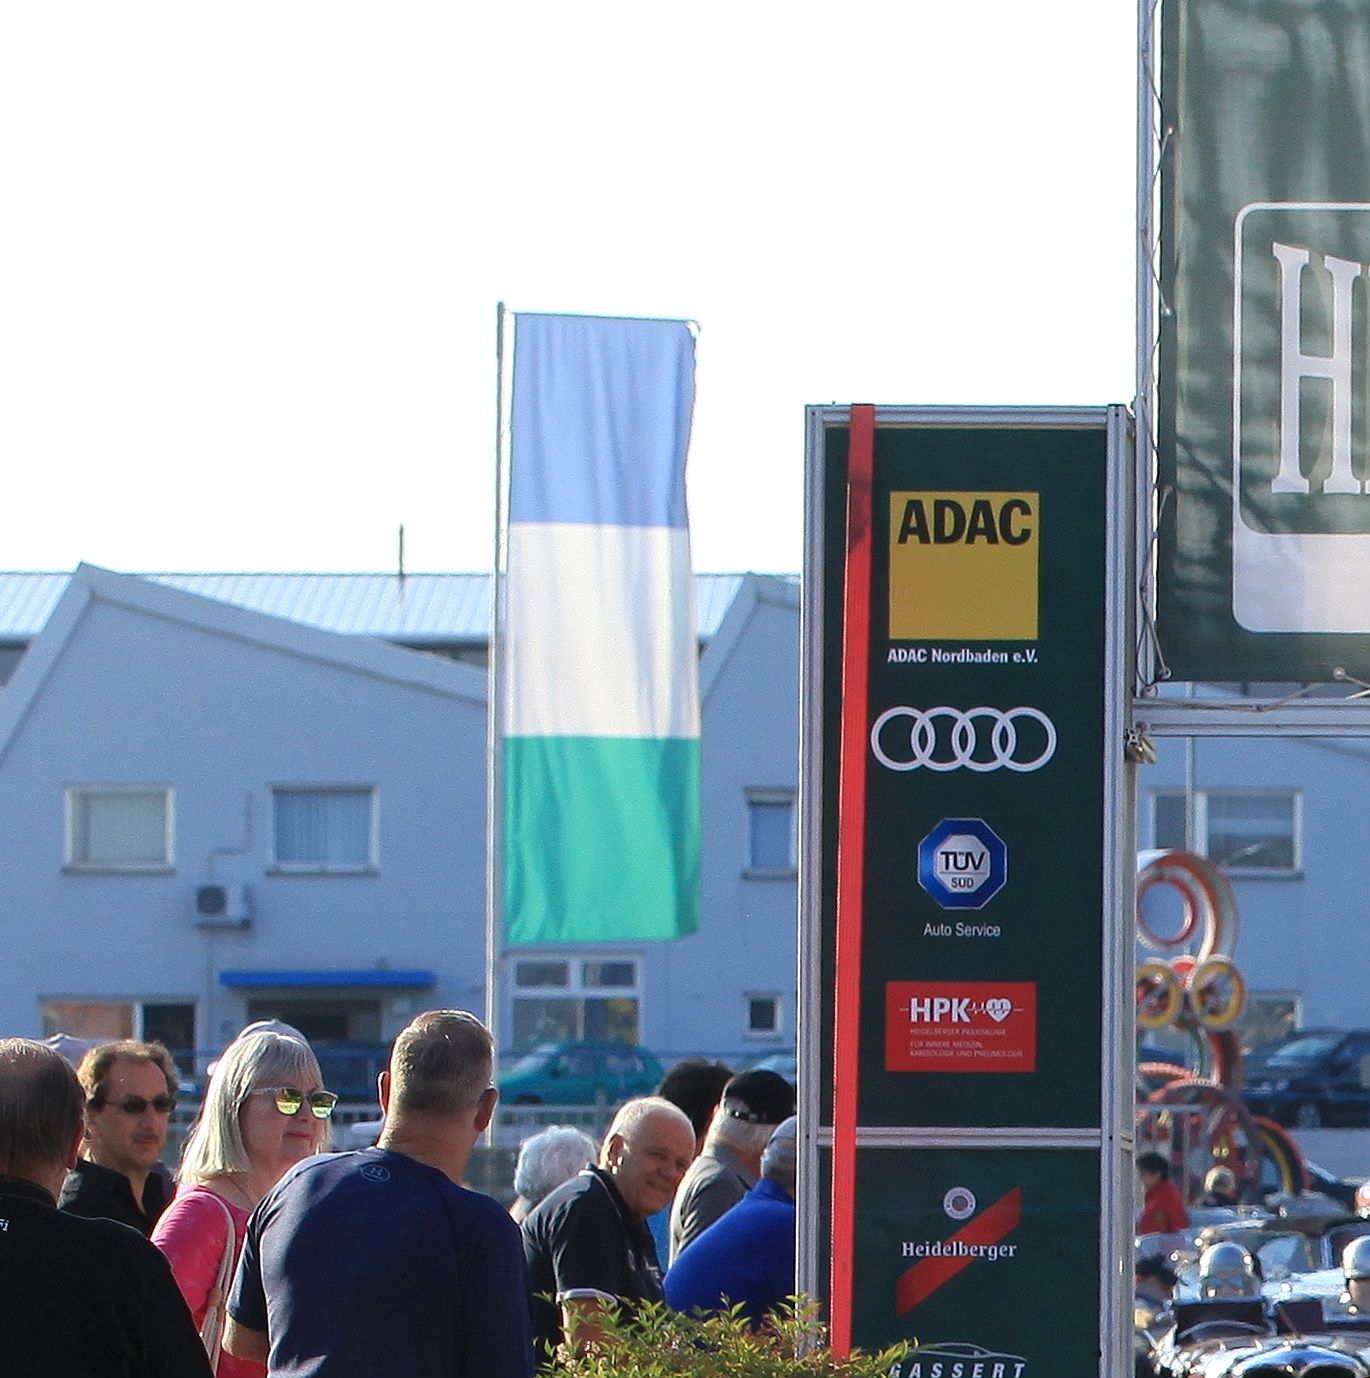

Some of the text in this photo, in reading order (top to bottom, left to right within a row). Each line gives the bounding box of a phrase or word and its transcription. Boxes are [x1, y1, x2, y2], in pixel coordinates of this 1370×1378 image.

[897, 498, 1032, 546] ADAC
[888, 649, 1039, 664] ADAC Nordbaden e.V.
[939, 851, 986, 872] TÜV
[951, 876, 975, 889] SÜD
[923, 923, 1001, 938] Auto Service
[909, 997, 972, 1023] HPK
[901, 1242, 1018, 1262] Heidelberger
[888, 1362, 1028, 1378] GASSERT
